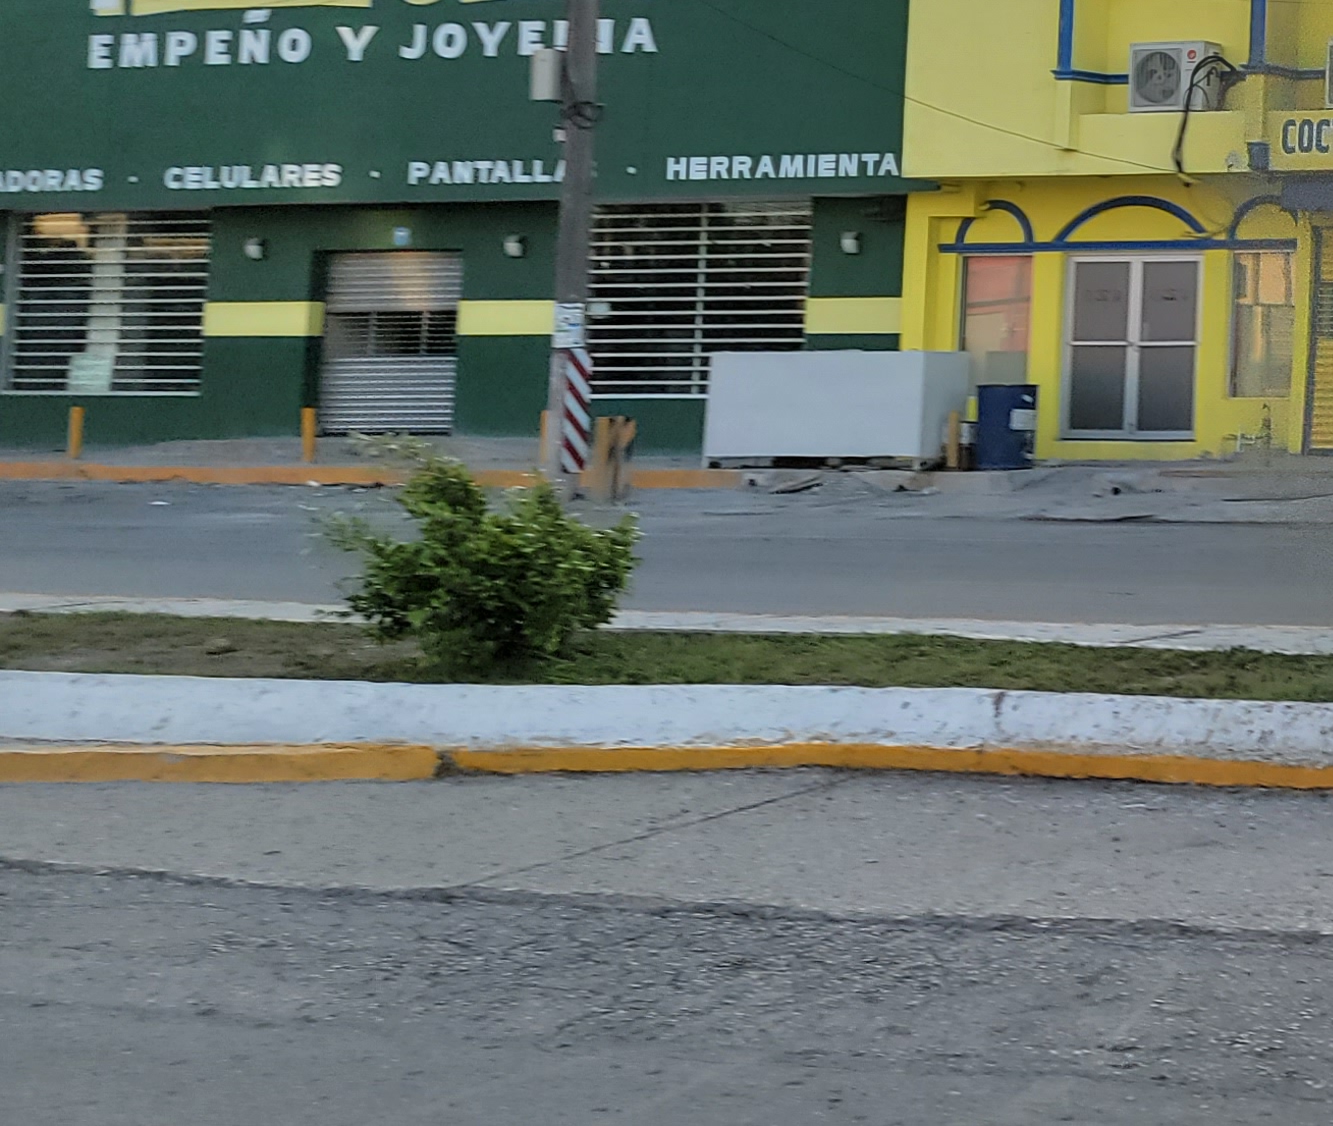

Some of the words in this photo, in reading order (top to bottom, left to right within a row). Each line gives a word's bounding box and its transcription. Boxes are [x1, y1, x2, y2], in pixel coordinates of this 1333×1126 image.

[87, 10, 312, 69] EMPEÑO
[335, 24, 379, 62] Y
[163, 162, 342, 190] CELULARES
[666, 152, 900, 181] HERRAMIENTA
